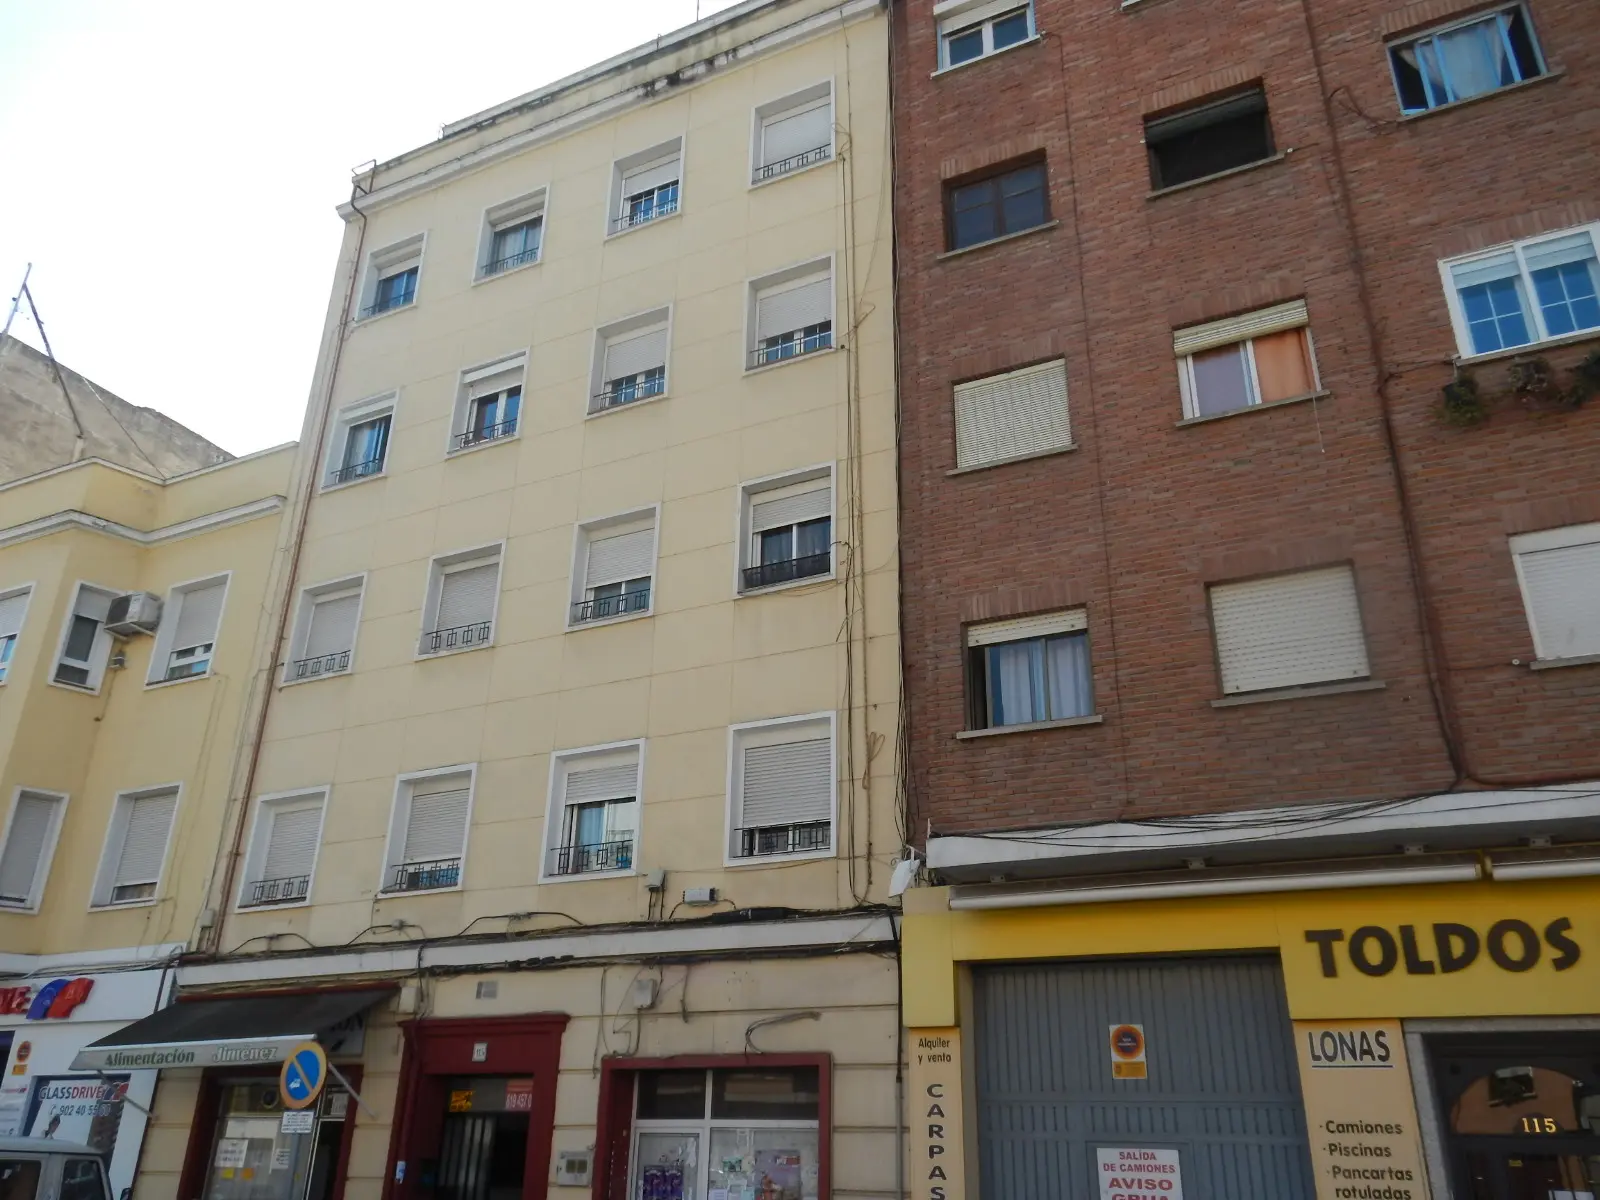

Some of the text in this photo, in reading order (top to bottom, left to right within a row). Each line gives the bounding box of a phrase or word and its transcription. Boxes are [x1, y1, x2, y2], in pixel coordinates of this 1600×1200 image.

[1304, 918, 1581, 978] TOLDOS
[918, 1037, 951, 1050] Alquiler
[1308, 1030, 1391, 1063] LONAS
[104, 1045, 279, 1067] Alimentación Jiménez
[917, 1052, 952, 1066] y venta
[39, 1084, 103, 1100] GLASSDRIVE
[60, 1104, 73, 1116] 902
[1325, 1120, 1404, 1135] Camiones
[1522, 1117, 1557, 1133] 115
[926, 1083, 947, 1200] CARPAS
[1119, 1151, 1157, 1161] SALIDA
[1328, 1142, 1392, 1158] Piscinas
[1103, 1163, 1176, 1174] DE CAMIONES
[1331, 1165, 1414, 1181] Pancartas
[1108, 1178, 1173, 1191] AVISO
[1335, 1185, 1412, 1200] rotuladas
